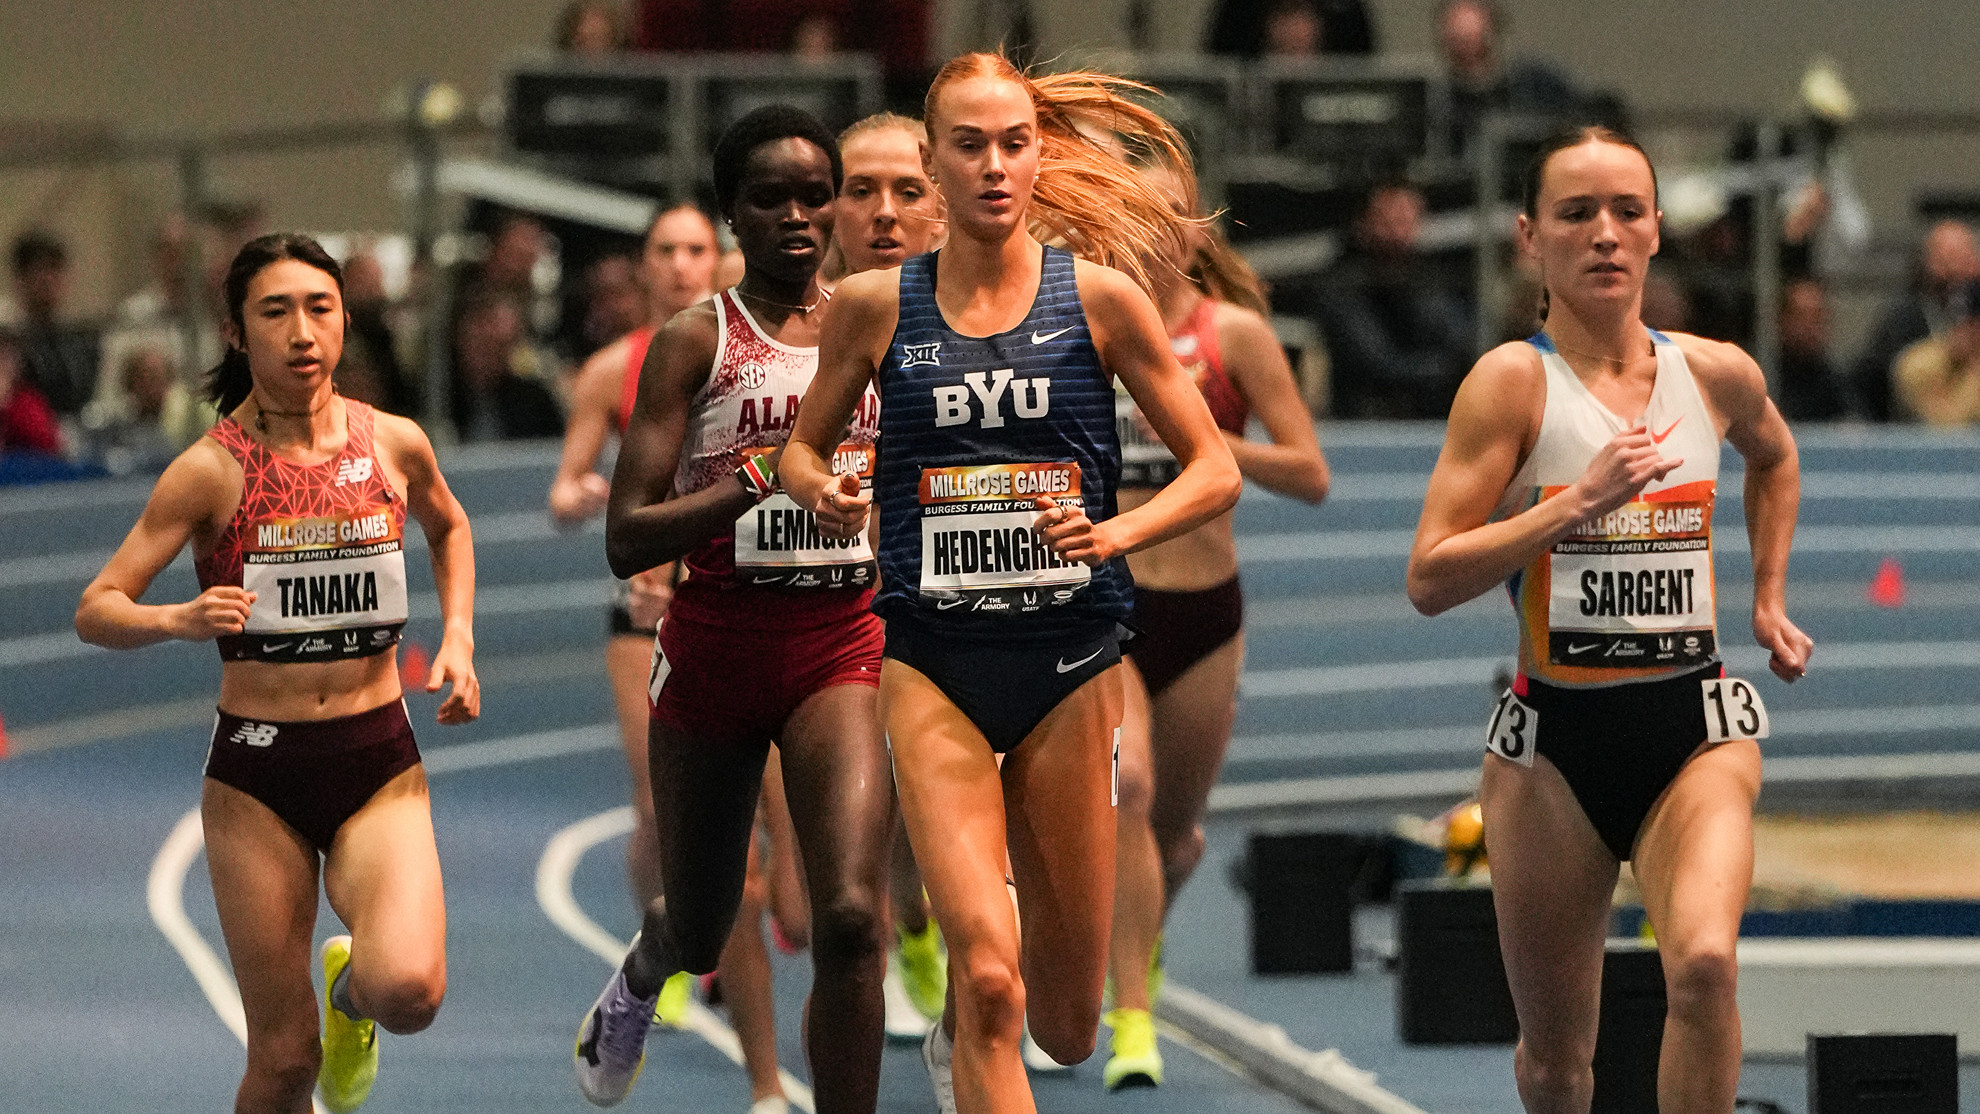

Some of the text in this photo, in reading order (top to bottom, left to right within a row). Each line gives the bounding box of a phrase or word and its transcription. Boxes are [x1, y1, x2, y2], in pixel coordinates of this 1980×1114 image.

[739, 363, 766, 389] SEC
[736, 394, 878, 434] ALAA
[933, 369, 1051, 429] BYU
[832, 450, 868, 475] GAMES
[929, 469, 1070, 498] MILLROSE GAMES
[925, 499, 1080, 515] BURGESS FAMILY FOUTION
[1571, 508, 1703, 536] LLROSE GAMES
[257, 513, 389, 547] MILLROSE GAMES
[757, 509, 861, 551] LEMN
[1556, 539, 1708, 553] BURGESS FAMILY FOUNDATION
[249, 541, 399, 563] BURGESS FAMILY FOUNDATION
[933, 526, 1079, 576] HEDENGR
[277, 571, 379, 618] TANAKA
[981, 603, 1010, 611] ARMORY
[1580, 568, 1694, 617] SARGENT
[1707, 681, 1759, 738] 13
[1488, 696, 1526, 758] 13
